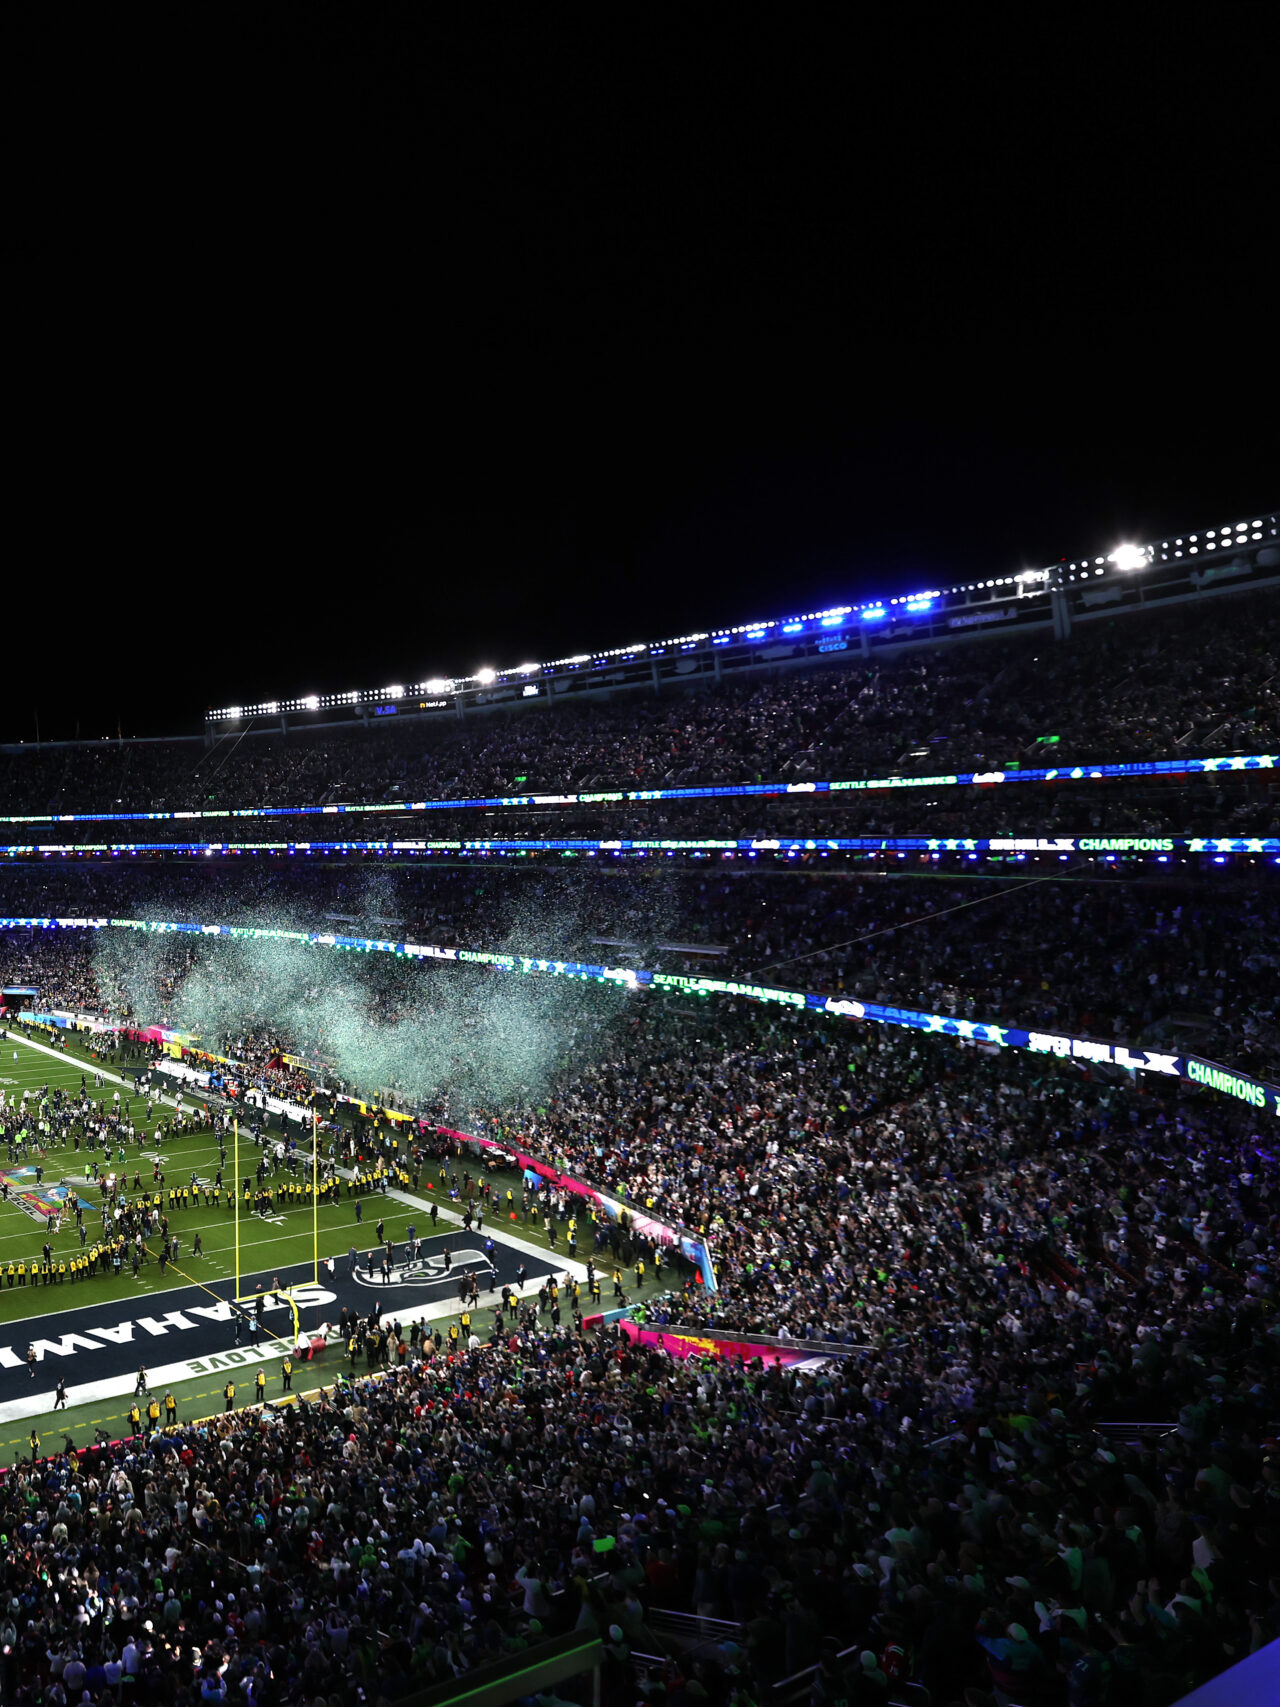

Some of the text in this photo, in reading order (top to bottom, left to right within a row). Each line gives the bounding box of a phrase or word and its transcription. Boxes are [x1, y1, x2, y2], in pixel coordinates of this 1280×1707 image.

[829, 775, 958, 789] SEATTLE SEAHAWKS
[579, 793, 623, 801] CHAMPIONS
[660, 840, 737, 848] SEAHAWKS
[1079, 839, 1174, 850] CHAMPIONS
[459, 951, 514, 966] CHAMPIONS
[653, 974, 805, 1004] SEATTLE SEAHAWKS
[1187, 1060, 1266, 1107] CHAMPIONS
[11, 1196, 36, 1216] BOWL
[186, 1347, 264, 1374] LOVE
